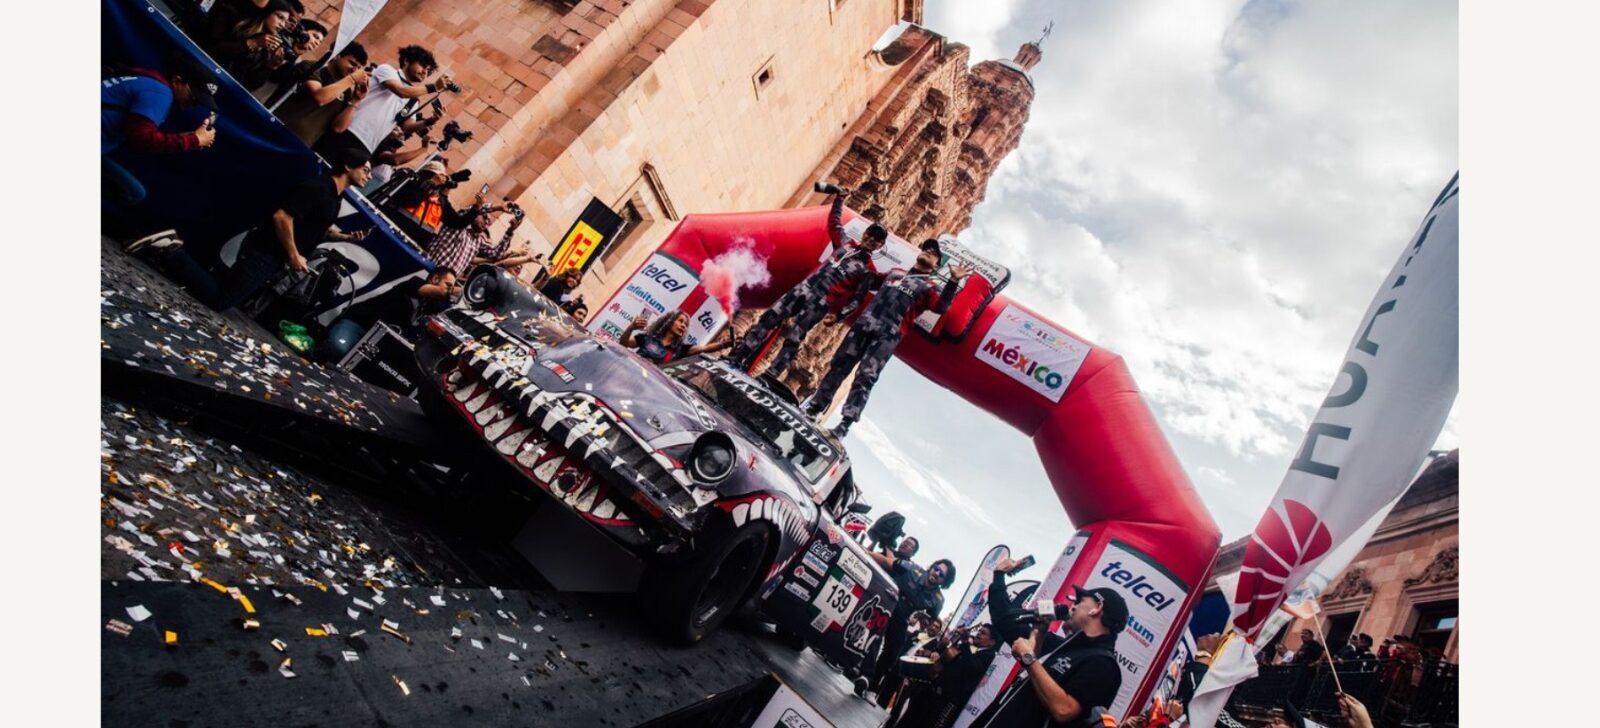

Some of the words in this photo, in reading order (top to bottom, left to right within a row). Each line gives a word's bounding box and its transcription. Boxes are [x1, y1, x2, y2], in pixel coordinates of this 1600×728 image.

[641, 262, 688, 293] telcel
[626, 282, 666, 313] infinitum
[619, 308, 634, 323] HUA
[698, 310, 716, 333] tel
[721, 372, 833, 457] MALDITILLO
[809, 539, 837, 562] telcel
[826, 584, 852, 613] 139
[1101, 561, 1175, 612] telcel
[1113, 651, 1139, 674] AWEI
